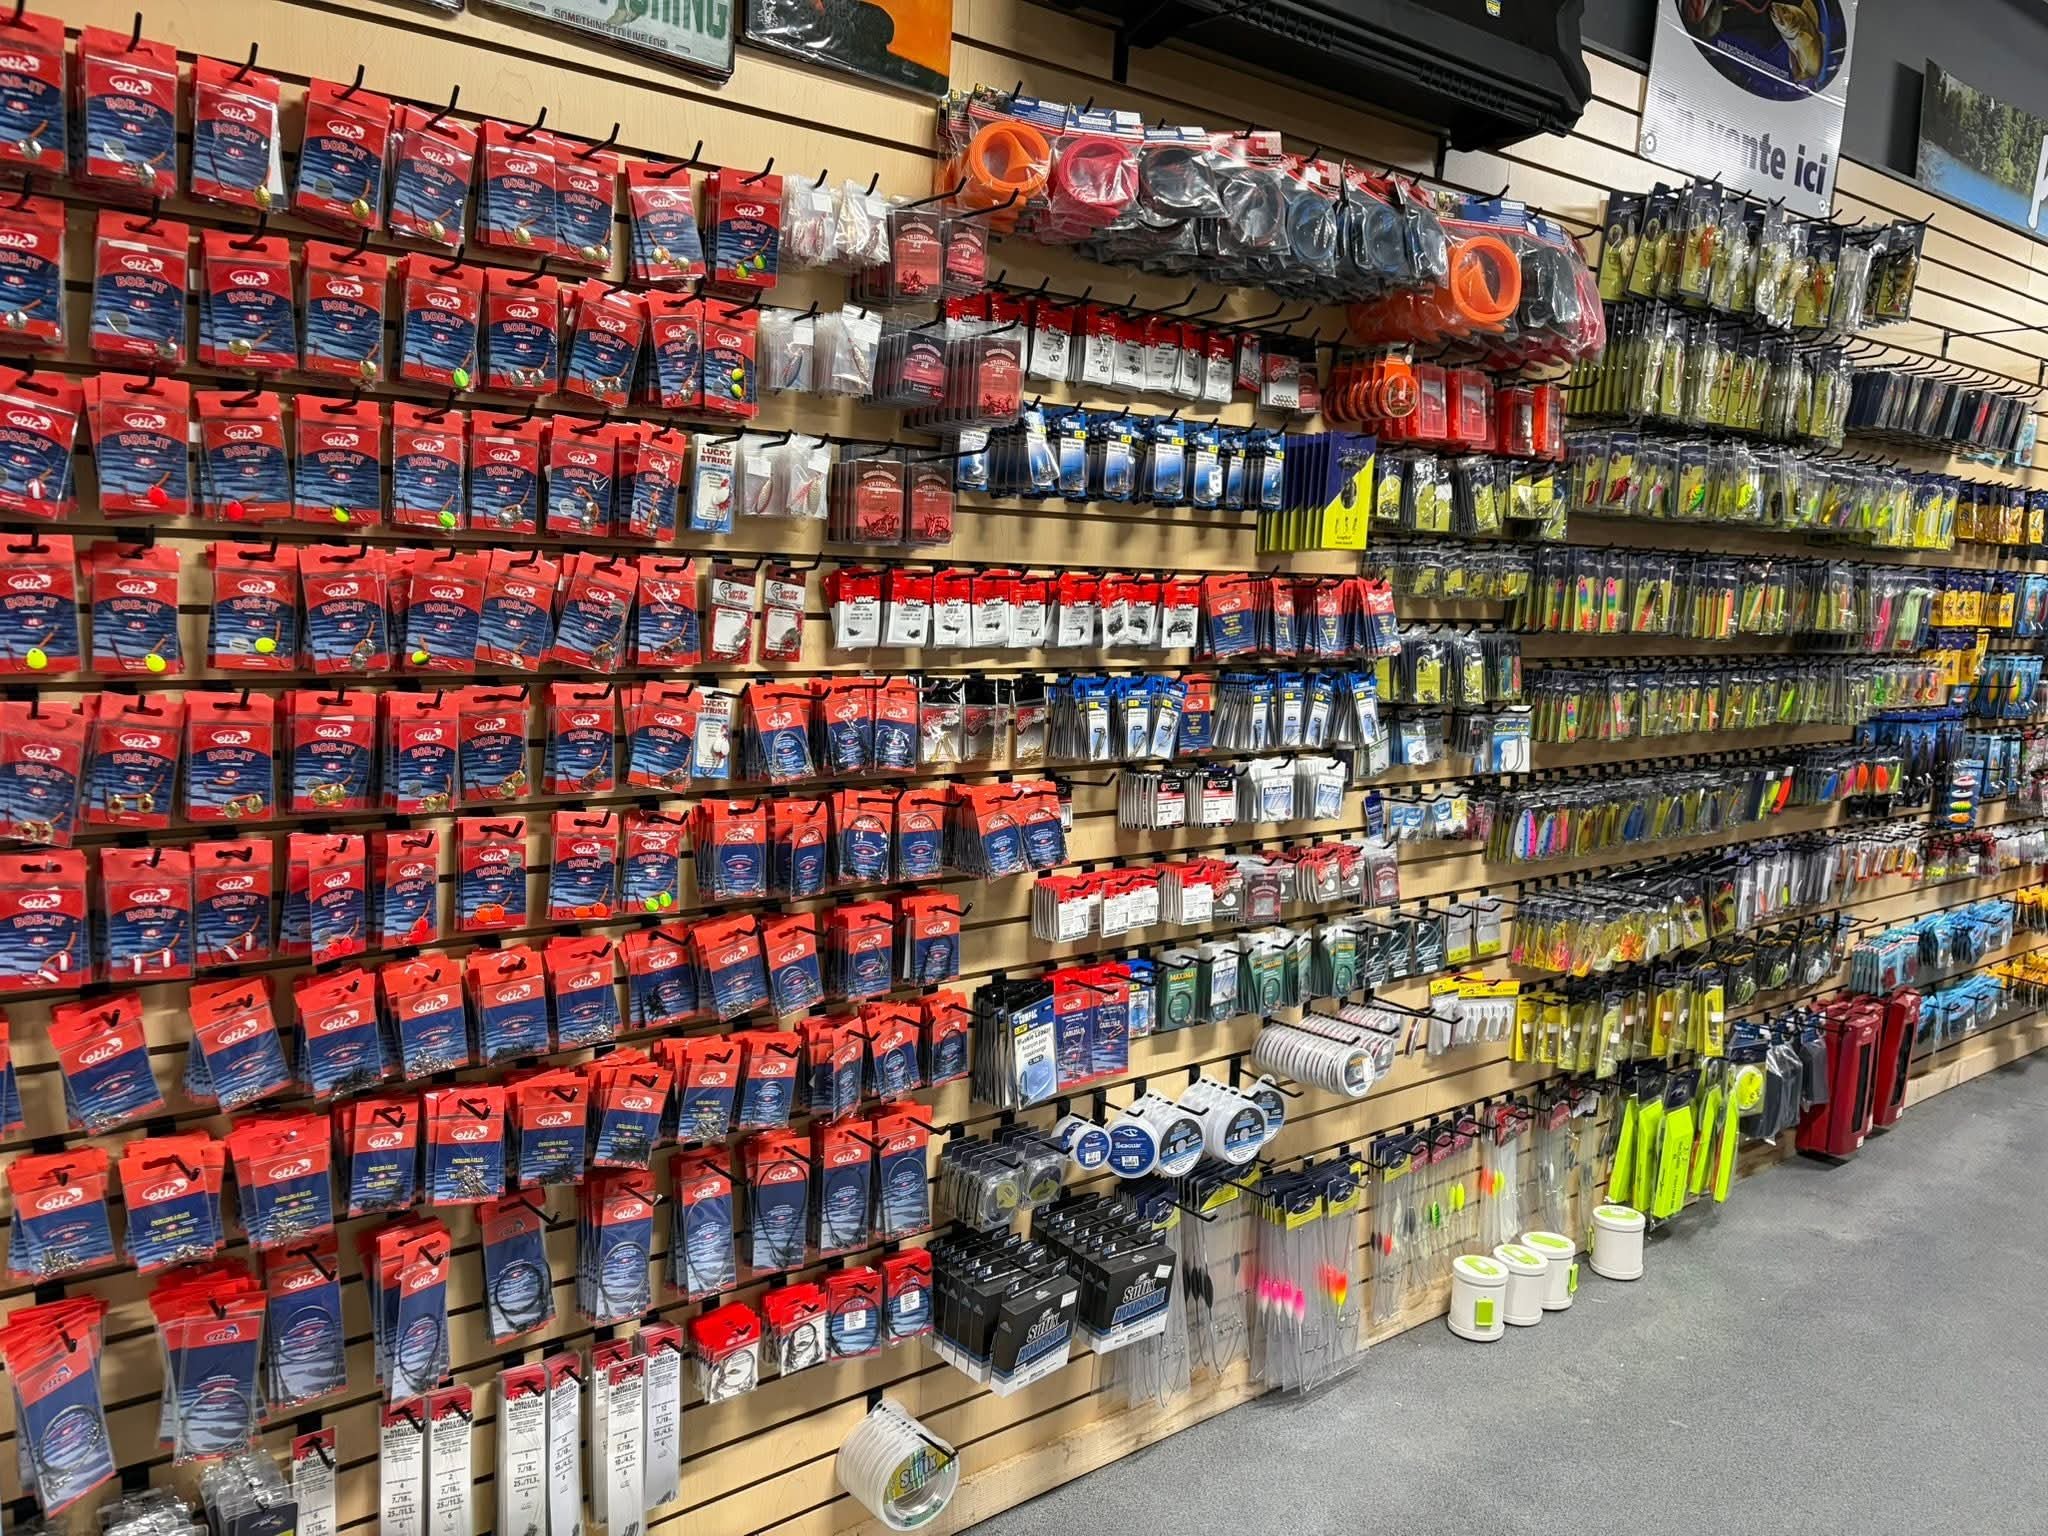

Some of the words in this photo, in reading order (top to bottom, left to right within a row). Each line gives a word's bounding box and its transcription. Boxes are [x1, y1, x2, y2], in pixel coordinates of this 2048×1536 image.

[553, 8, 610, 32] SOMETHING
[648, 37, 669, 49] FOR
[113, 76, 151, 95] etic
[105, 97, 158, 117] BOB-IT
[220, 104, 255, 122] etic
[211, 122, 259, 142] BOB-IT
[330, 122, 364, 140] etic
[321, 139, 366, 160] BOB-IT
[423, 148, 453, 166] etic
[414, 161, 454, 186] BOB-IT
[508, 161, 537, 176] etic
[1793, 143, 1828, 195] ici
[502, 177, 542, 194] BOB-IT
[571, 176, 599, 192] etic
[651, 195, 675, 208] etic
[737, 204, 764, 218] etic
[124, 257, 163, 273] etic
[116, 276, 167, 294] BOB-IT
[233, 272, 268, 286] etic
[329, 282, 362, 298] etic
[227, 290, 275, 306] BOB-IT
[428, 294, 460, 310] etic
[321, 300, 368, 317] BOB-IT
[509, 306, 538, 320] etic
[421, 311, 464, 328] BOB-IT
[598, 317, 625, 334] etic
[502, 322, 542, 336] BOB-IT
[589, 331, 626, 350] BOB-IT
[718, 333, 740, 348] etic
[11, 412, 50, 430] etic
[127, 414, 165, 430] etic
[227, 426, 261, 440] etic
[120, 434, 171, 450] BOB-IT
[325, 434, 357, 448] etic
[415, 439, 444, 453] etic
[223, 446, 270, 458] BOB-IT
[492, 449, 519, 462] etic
[570, 452, 596, 466] etic
[702, 447, 732, 458] LUCKY
[318, 454, 362, 466] BOB-IT
[408, 457, 448, 470] BOB-IT
[700, 455, 733, 466] STRIKE
[486, 466, 524, 478] BOB-IT
[11, 576, 50, 590] etic
[119, 581, 156, 595] etic
[241, 580, 274, 594] etic
[326, 584, 357, 598] etic
[432, 586, 463, 600] etic
[507, 584, 535, 598] etic
[588, 588, 614, 602] etic
[6, 596, 59, 610] BOB-IT
[112, 600, 161, 612] BOB-IT
[233, 599, 280, 612] BOB-IT
[322, 602, 366, 615] BOB-IT
[425, 604, 466, 616] BOB-IT
[498, 599, 536, 615] BOB-IT
[477, 719, 504, 732] etic
[574, 716, 599, 728] etic
[656, 715, 682, 728] etic
[215, 731, 249, 744] etic
[318, 726, 351, 738] etic
[417, 729, 441, 742] etic
[568, 731, 604, 742] BOB-IT
[649, 728, 682, 742] BOB-IT
[123, 735, 159, 749] etic
[312, 742, 355, 756] BOB-IT
[473, 736, 510, 748] BOB-IT
[25, 746, 60, 762] etic
[113, 753, 162, 767] BOB-IT
[208, 750, 254, 762] BOB-IT
[412, 748, 445, 758] BOB-IT
[16, 764, 64, 781] BOB-IT
[1264, 786, 1291, 794] Mustad
[1319, 784, 1341, 793] Mustad
[574, 844, 599, 854] etic
[643, 840, 666, 850] etic
[482, 851, 508, 862] etic
[638, 856, 670, 864] BOB-IT
[476, 867, 512, 878] BOB-IT
[219, 877, 252, 891] etic
[326, 874, 349, 888] etic
[396, 881, 426, 893] BOB-IT
[22, 895, 60, 909] etic
[133, 890, 170, 903] etic
[212, 896, 257, 908] BOB-IT
[321, 891, 354, 905] BOB-IT
[13, 916, 65, 927] BOB-IT
[126, 910, 178, 922] BOB-IT
[926, 922, 949, 936] etic
[651, 954, 676, 968] etic
[722, 948, 747, 964] etic
[780, 946, 803, 962] etic
[571, 974, 599, 988] etic
[1168, 970, 1198, 982] MAXIMA
[499, 986, 529, 1002] etic
[415, 996, 447, 1014] etic
[323, 1012, 357, 1031] etic
[220, 1022, 256, 1045] etic
[82, 1040, 121, 1064] etic
[761, 1064, 785, 1076] etic
[702, 1073, 725, 1085] etic
[623, 1097, 650, 1110] etic
[540, 1112, 570, 1126] etic
[455, 1127, 487, 1140] etic
[371, 1134, 403, 1148] etic
[891, 1138, 915, 1152] etic
[1114, 1141, 1142, 1150] Seaguar
[835, 1150, 860, 1162] etic
[272, 1161, 311, 1180] etic
[770, 1168, 797, 1182] etic
[146, 1181, 186, 1201] etic
[695, 1184, 719, 1200] etic
[40, 1190, 81, 1210] etic
[615, 1206, 641, 1220] etic
[412, 1271, 438, 1290] etic
